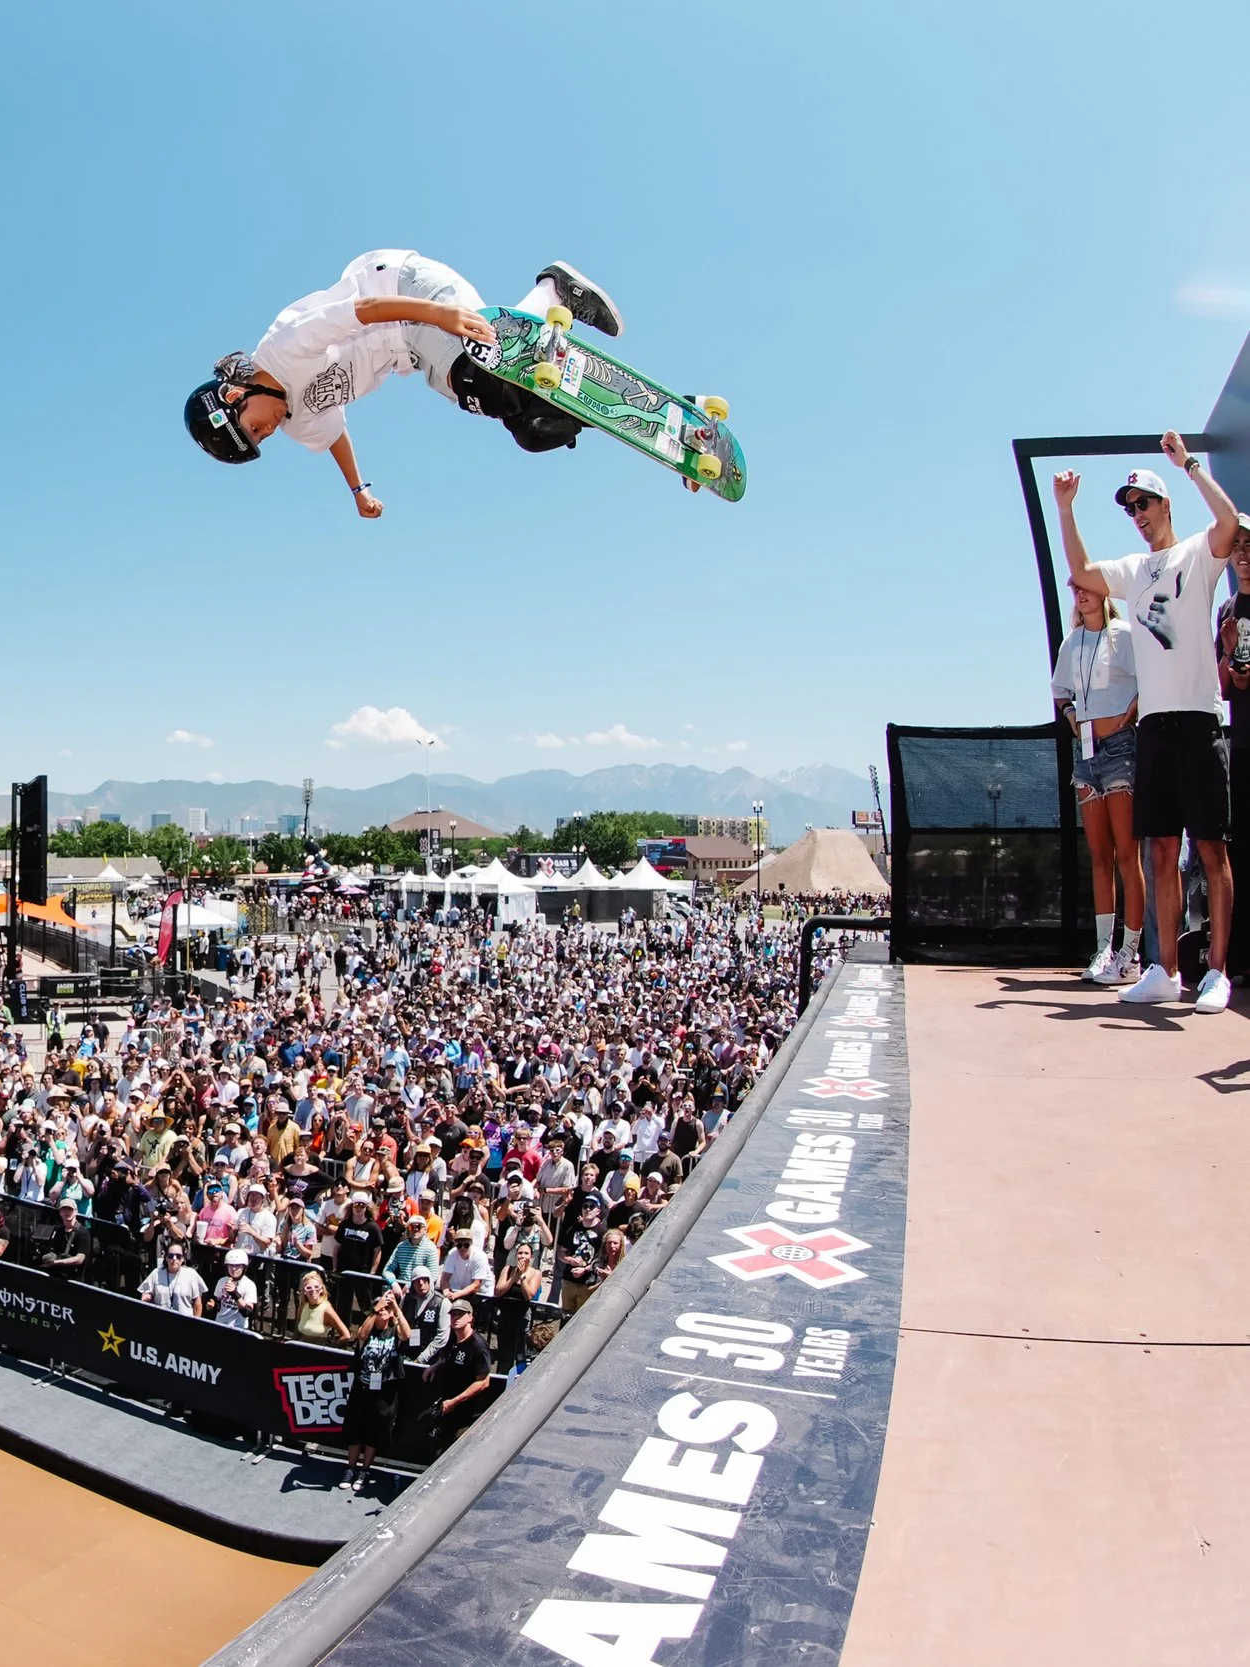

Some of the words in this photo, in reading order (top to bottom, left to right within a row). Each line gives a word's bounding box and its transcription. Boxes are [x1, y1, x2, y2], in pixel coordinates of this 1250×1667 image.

[63, 882, 111, 891] WOODWARD
[824, 1040, 873, 1078] GAMES
[786, 1108, 854, 1128] 30
[765, 1133, 856, 1224] GAMES
[130, 1340, 162, 1369] U.S.
[164, 1352, 222, 1385] ARMY
[792, 1327, 851, 1380] YEARS
[282, 1372, 355, 1403] TECH
[293, 1398, 349, 1426] DEC
[520, 1391, 778, 1667] AMES
[660, 1311, 795, 1372] 30
